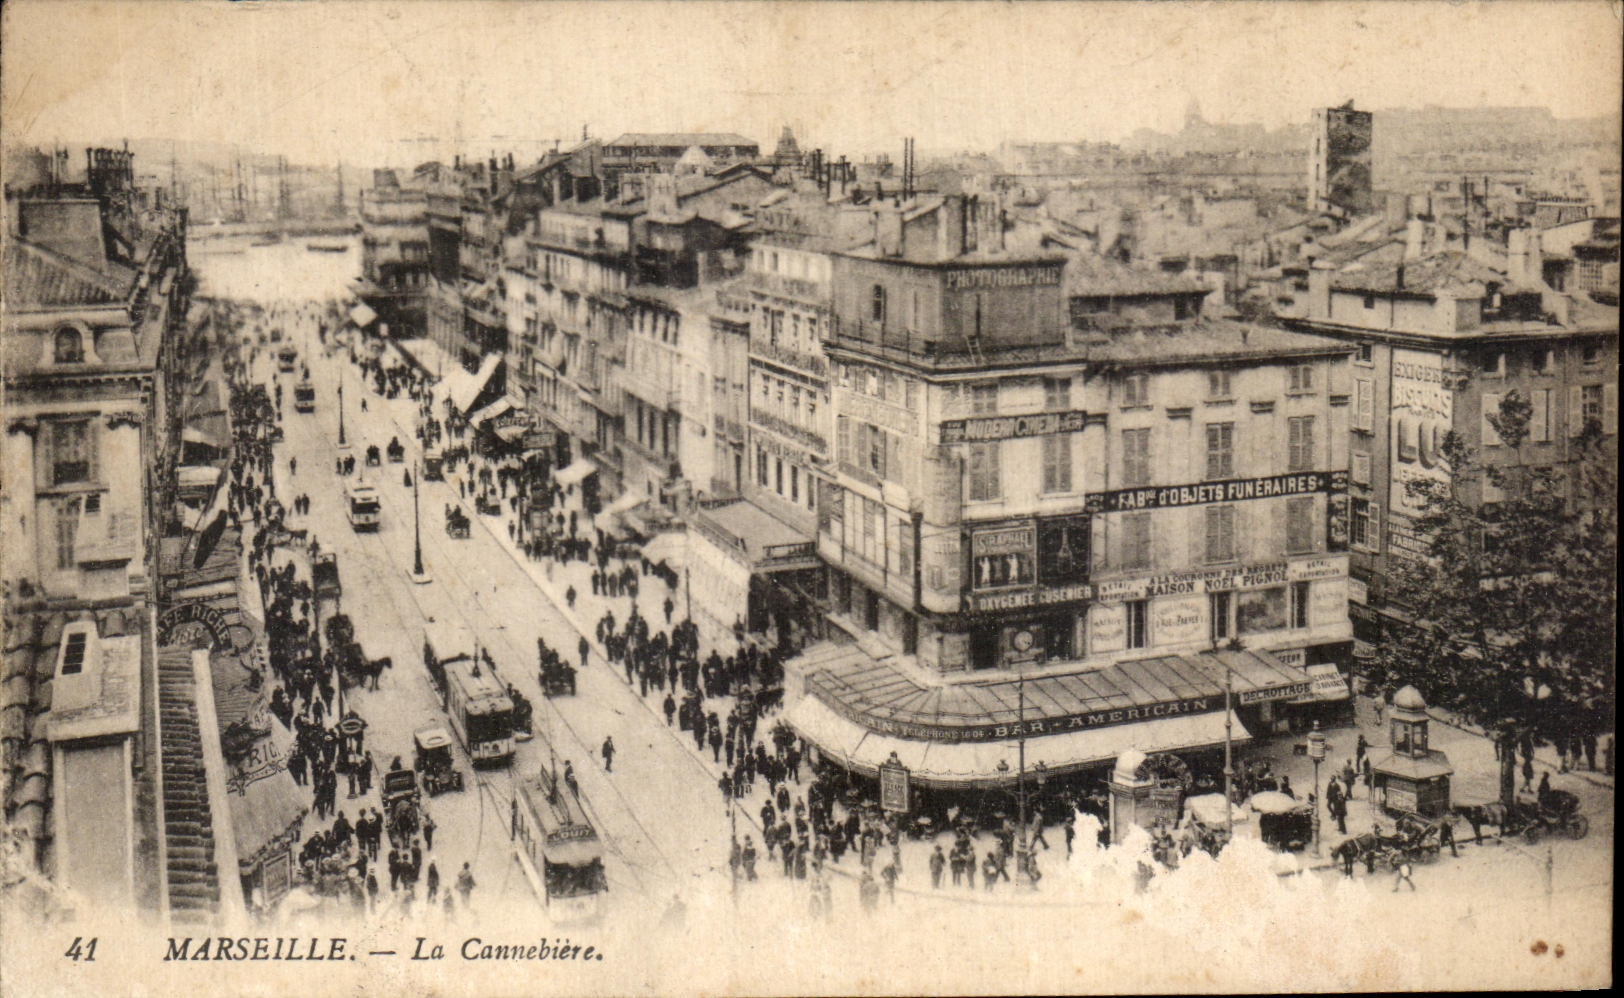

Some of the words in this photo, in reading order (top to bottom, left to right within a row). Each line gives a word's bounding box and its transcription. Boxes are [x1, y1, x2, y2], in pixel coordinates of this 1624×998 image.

[946, 267, 1061, 289] PHOTOGRAPHIE
[1158, 484, 1225, 505] d'OBJETS
[1227, 475, 1319, 499] FUNÉRAIRES
[1145, 582, 1195, 597] MAISON
[1243, 570, 1289, 587] PIGNOL
[1173, 571, 1221, 583] COURONNE
[1225, 568, 1243, 577] DES
[994, 721, 1045, 738] BAR
[1068, 700, 1209, 728] AMERICAIN
